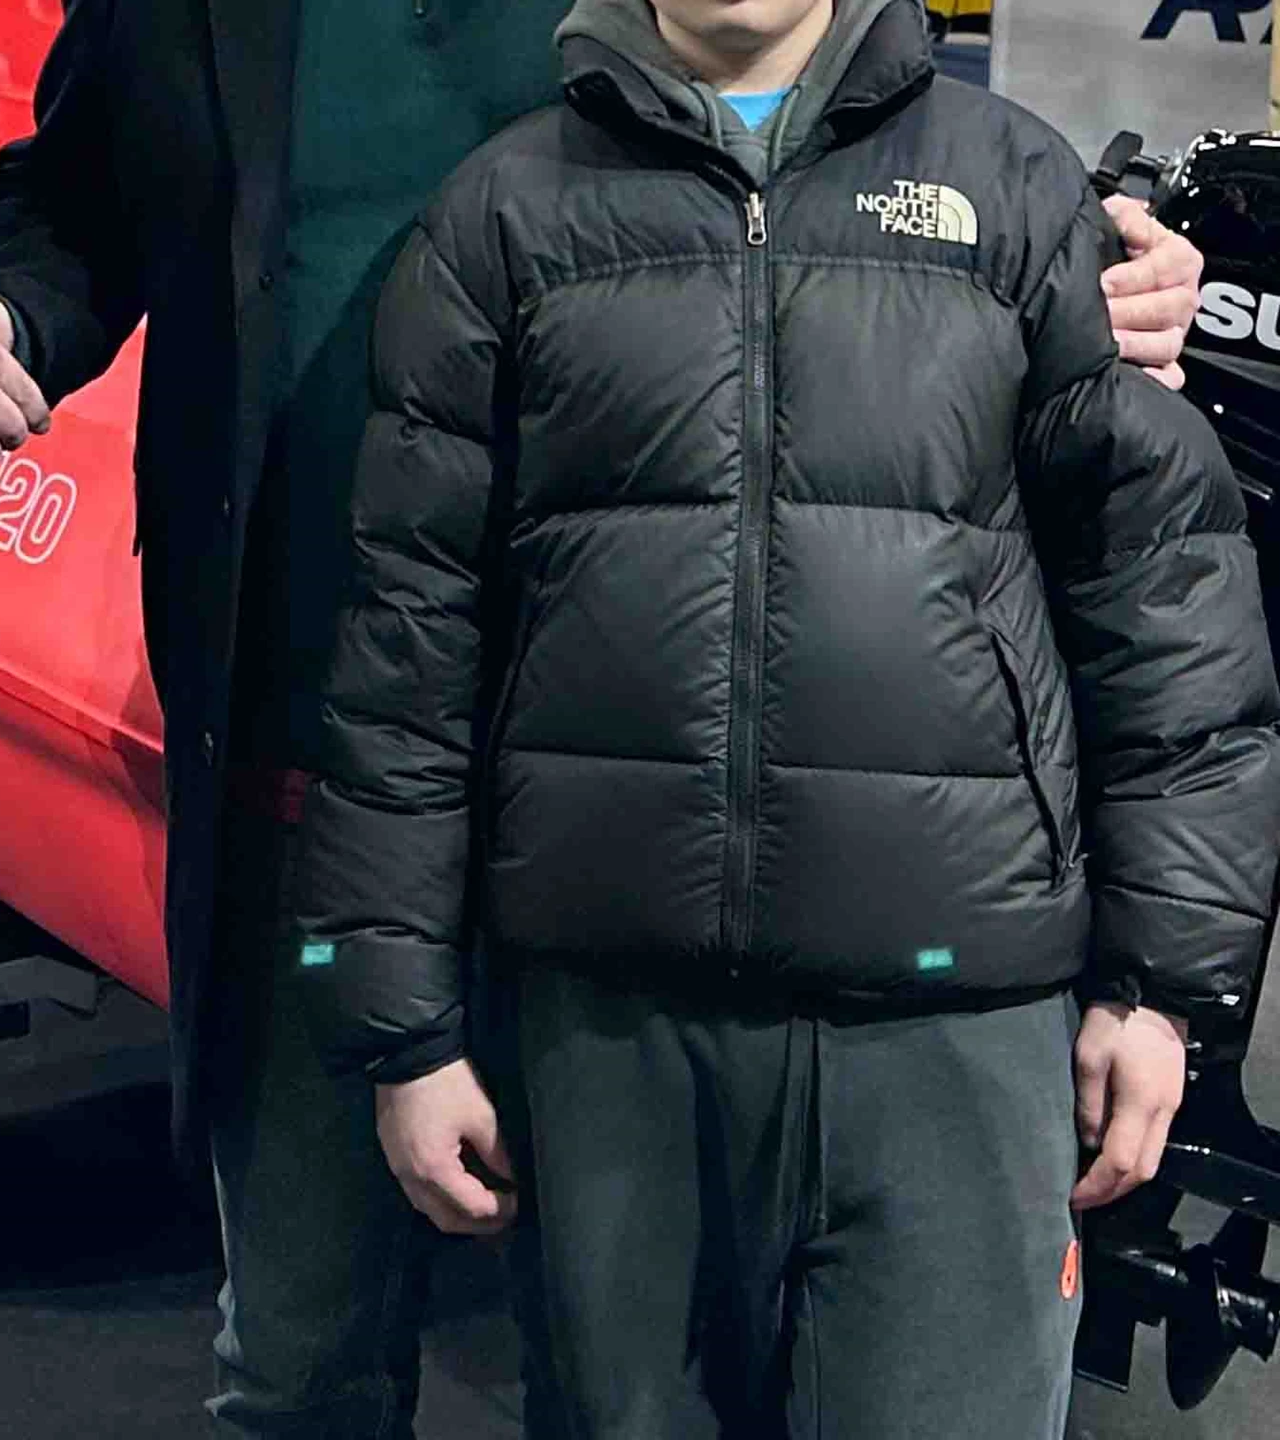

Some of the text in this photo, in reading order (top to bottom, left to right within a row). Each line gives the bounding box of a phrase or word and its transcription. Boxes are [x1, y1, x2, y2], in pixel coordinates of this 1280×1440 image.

[893, 179, 939, 201] THE
[856, 193, 937, 219] NORTH
[880, 213, 937, 238] FACE
